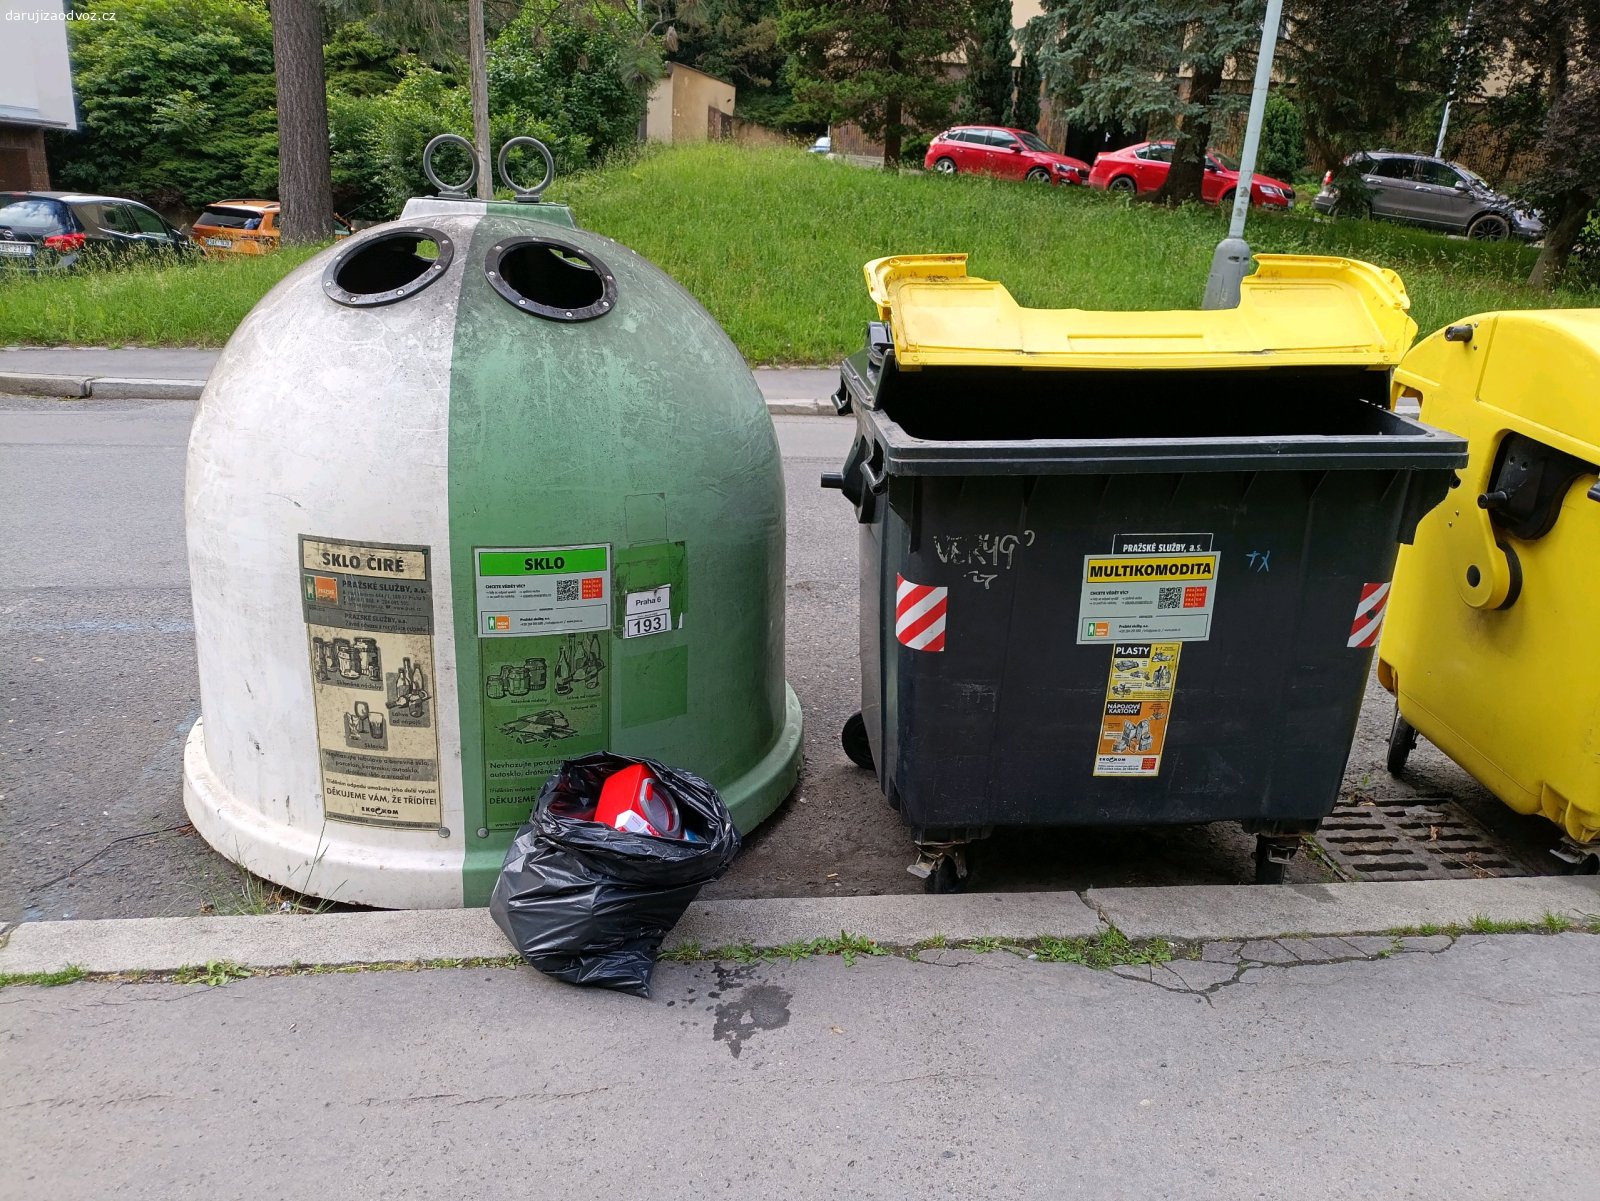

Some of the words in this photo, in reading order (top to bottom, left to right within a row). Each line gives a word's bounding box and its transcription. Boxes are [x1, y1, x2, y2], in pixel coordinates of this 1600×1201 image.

[1122, 542, 1157, 553] PRAŽSKÉ
[1158, 542, 1187, 553] SLUŽBY,
[321, 552, 360, 569] SKLO
[366, 554, 405, 573] ČIRÉ
[524, 556, 565, 571] SKLO
[1090, 562, 1212, 578] MULTIKOMODITA
[342, 580, 379, 591] PRAŽSKÉ
[379, 582, 412, 594] SLUŽBY,
[635, 598, 656, 607] Praha
[633, 616, 662, 634] 193
[1115, 646, 1150, 655] PLASTY
[1107, 702, 1141, 710] NÁPOJOVÉ
[489, 760, 532, 770] Nevhazujte
[326, 786, 367, 801] DĚKUJEME
[368, 792, 390, 804] VÁM,
[391, 795, 402, 804] ŽE
[403, 796, 437, 806] TŘÍDÍTE!
[489, 795, 536, 805] DĚKUJEME
